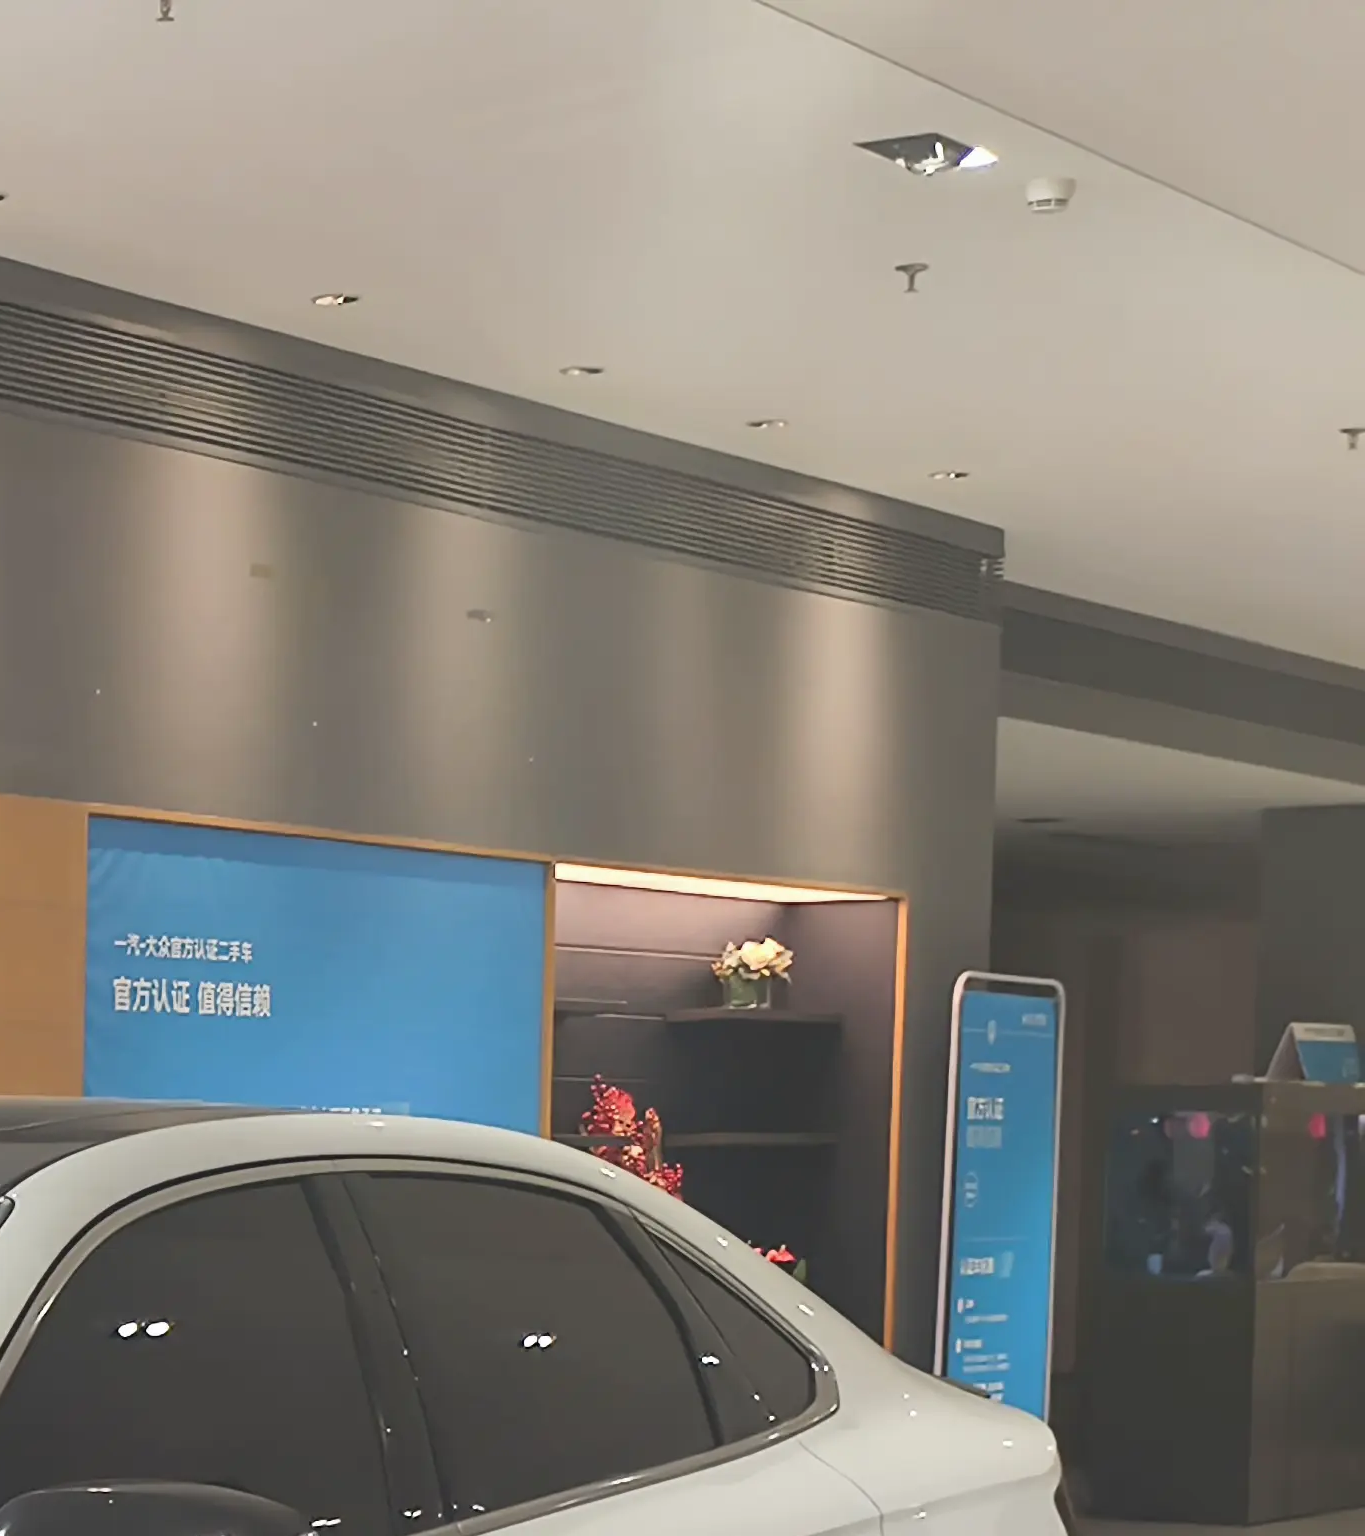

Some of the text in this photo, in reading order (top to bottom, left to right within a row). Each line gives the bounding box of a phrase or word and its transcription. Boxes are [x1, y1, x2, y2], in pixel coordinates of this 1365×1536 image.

[113, 975, 271, 1017] 官方认证 值得信赖
